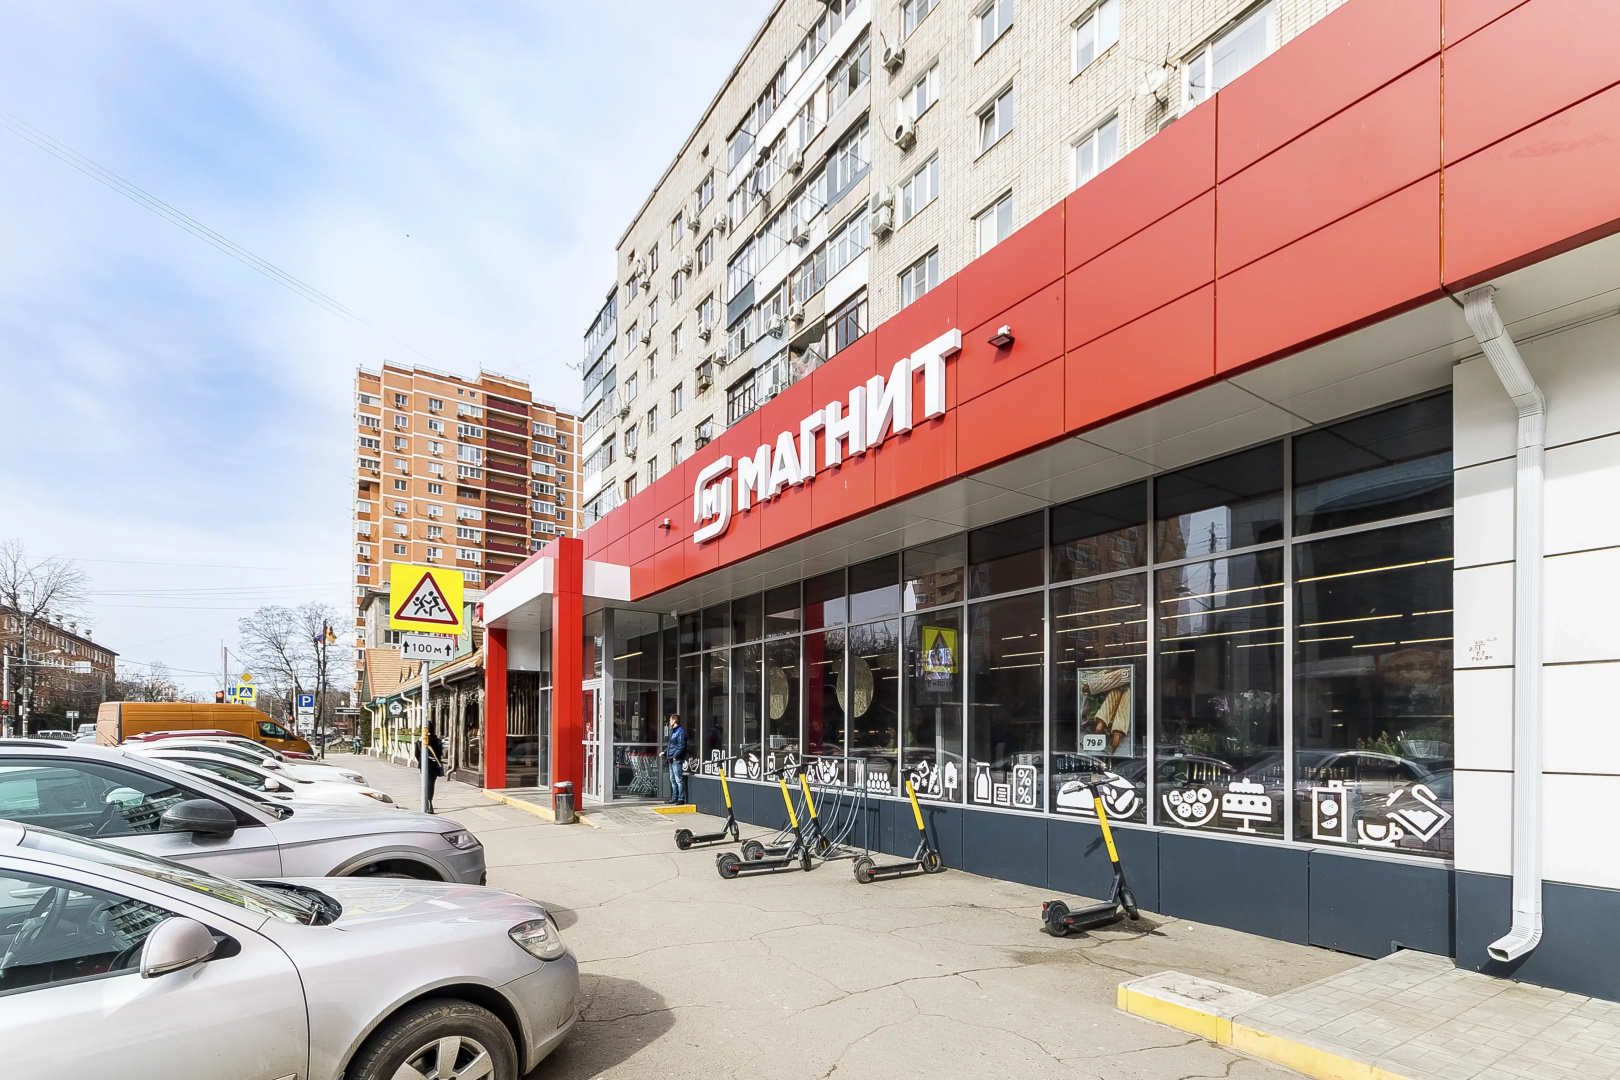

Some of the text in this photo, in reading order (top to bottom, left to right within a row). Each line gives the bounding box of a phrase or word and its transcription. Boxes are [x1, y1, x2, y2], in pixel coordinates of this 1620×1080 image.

[737, 328, 962, 513] МАГНИТ
[412, 643, 432, 653] 100
[302, 695, 311, 707] P
